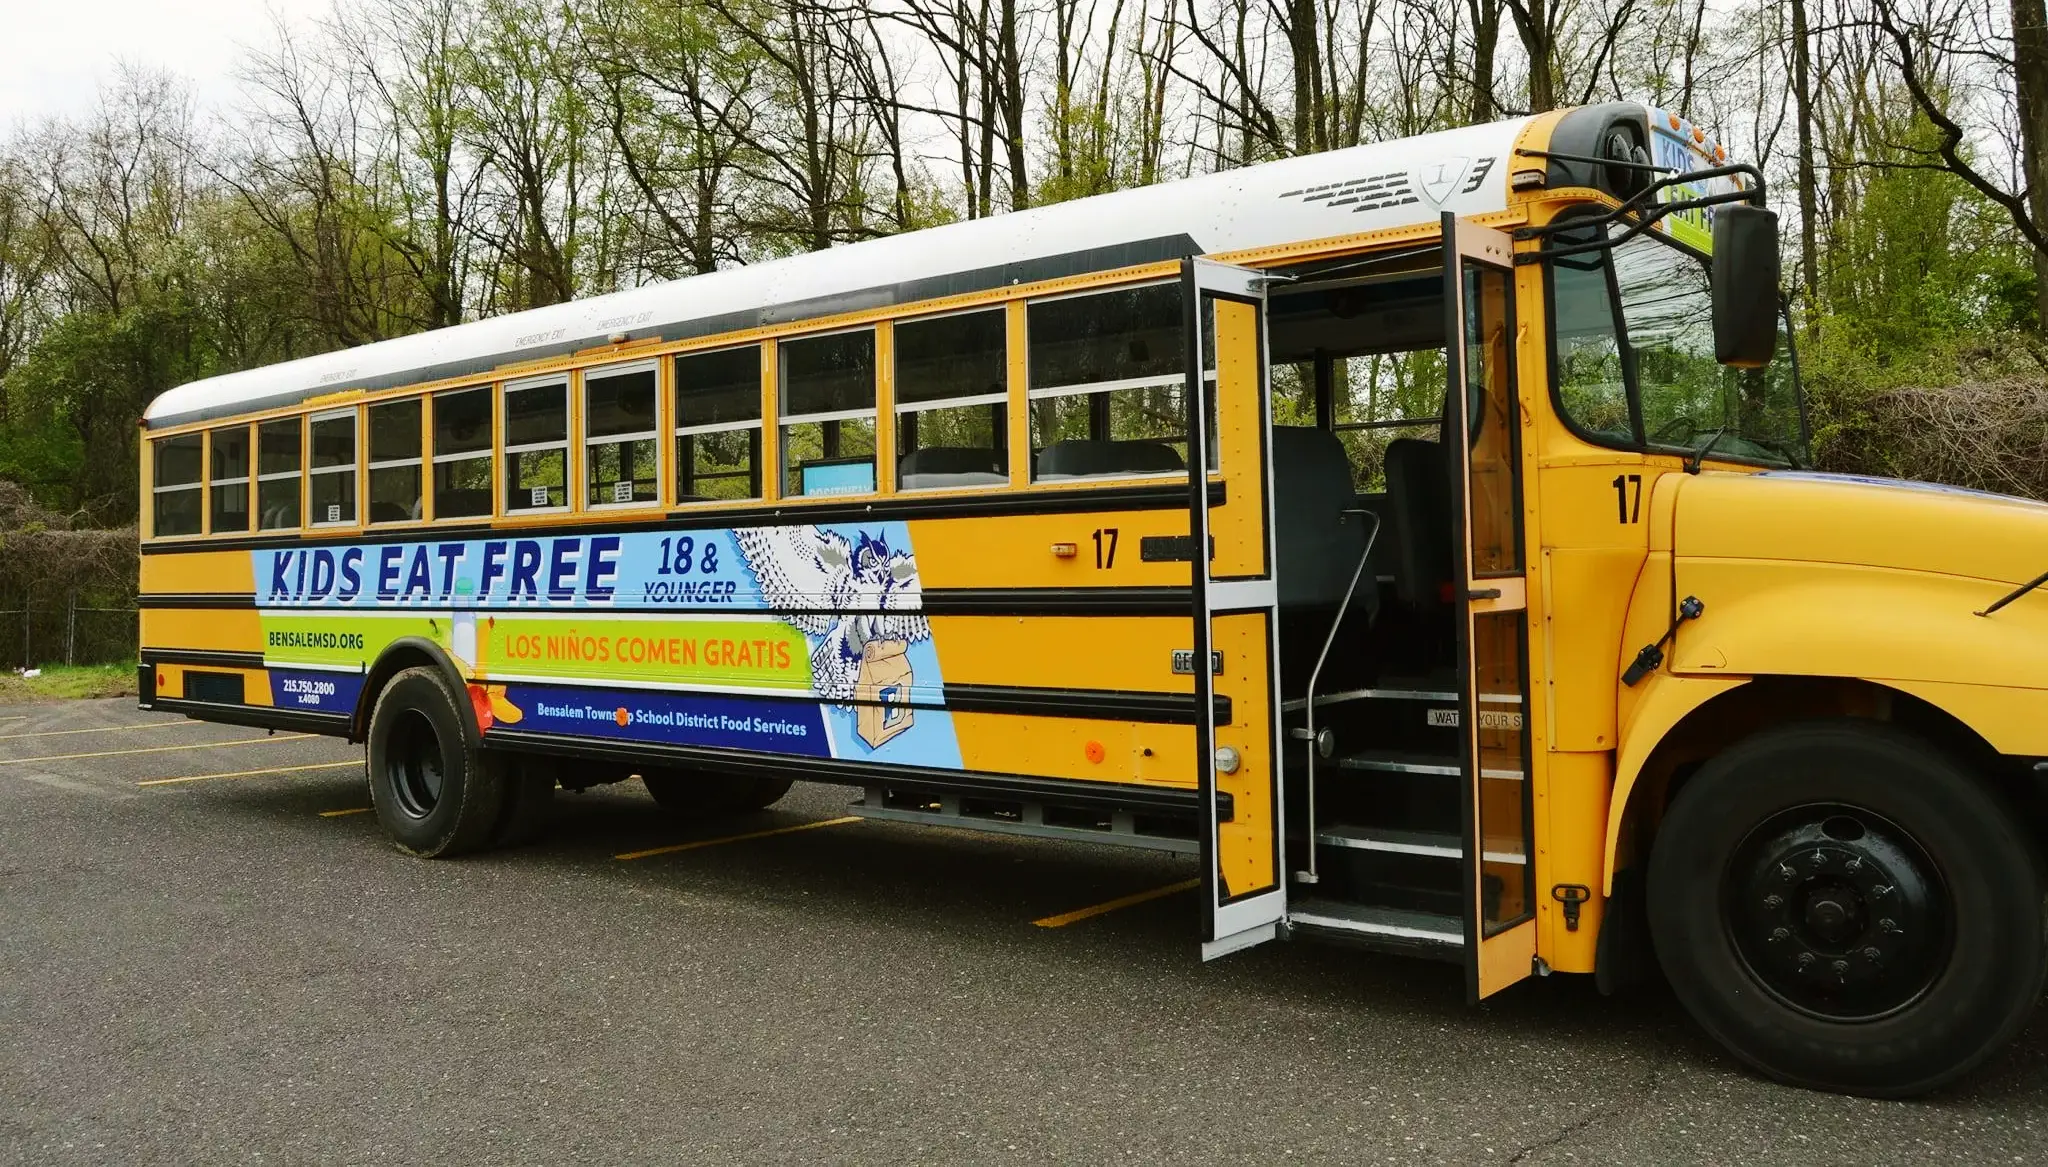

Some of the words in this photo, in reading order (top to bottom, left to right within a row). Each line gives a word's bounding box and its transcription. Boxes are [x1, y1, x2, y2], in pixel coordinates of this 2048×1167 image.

[636, 310, 654, 324] EXIT
[551, 328, 567, 341] EXIT
[1613, 474, 1642, 524] 17
[657, 535, 694, 576] 18
[701, 542, 719, 574] &
[1092, 528, 1119, 570] 17
[268, 547, 364, 602] KIDS
[375, 542, 467, 602] EAT
[476, 536, 621, 602] FREE
[643, 580, 737, 604] YOUNGER
[269, 631, 364, 649] BENSALEMSD.ORG
[506, 634, 542, 660] LOS
[547, 629, 610, 663] NIÑOS
[616, 636, 697, 666] COMEN
[703, 638, 792, 670] GRATIS
[283, 679, 335, 696] 215.750.2800
[537, 703, 583, 720] Bensalem
[585, 705, 634, 726] Townsp
[636, 709, 674, 727] School
[676, 711, 719, 730] District
[721, 713, 751, 732] Food
[753, 717, 807, 737] Services
[1435, 711, 1459, 725] WAT
[1479, 713, 1509, 727] YOUR
